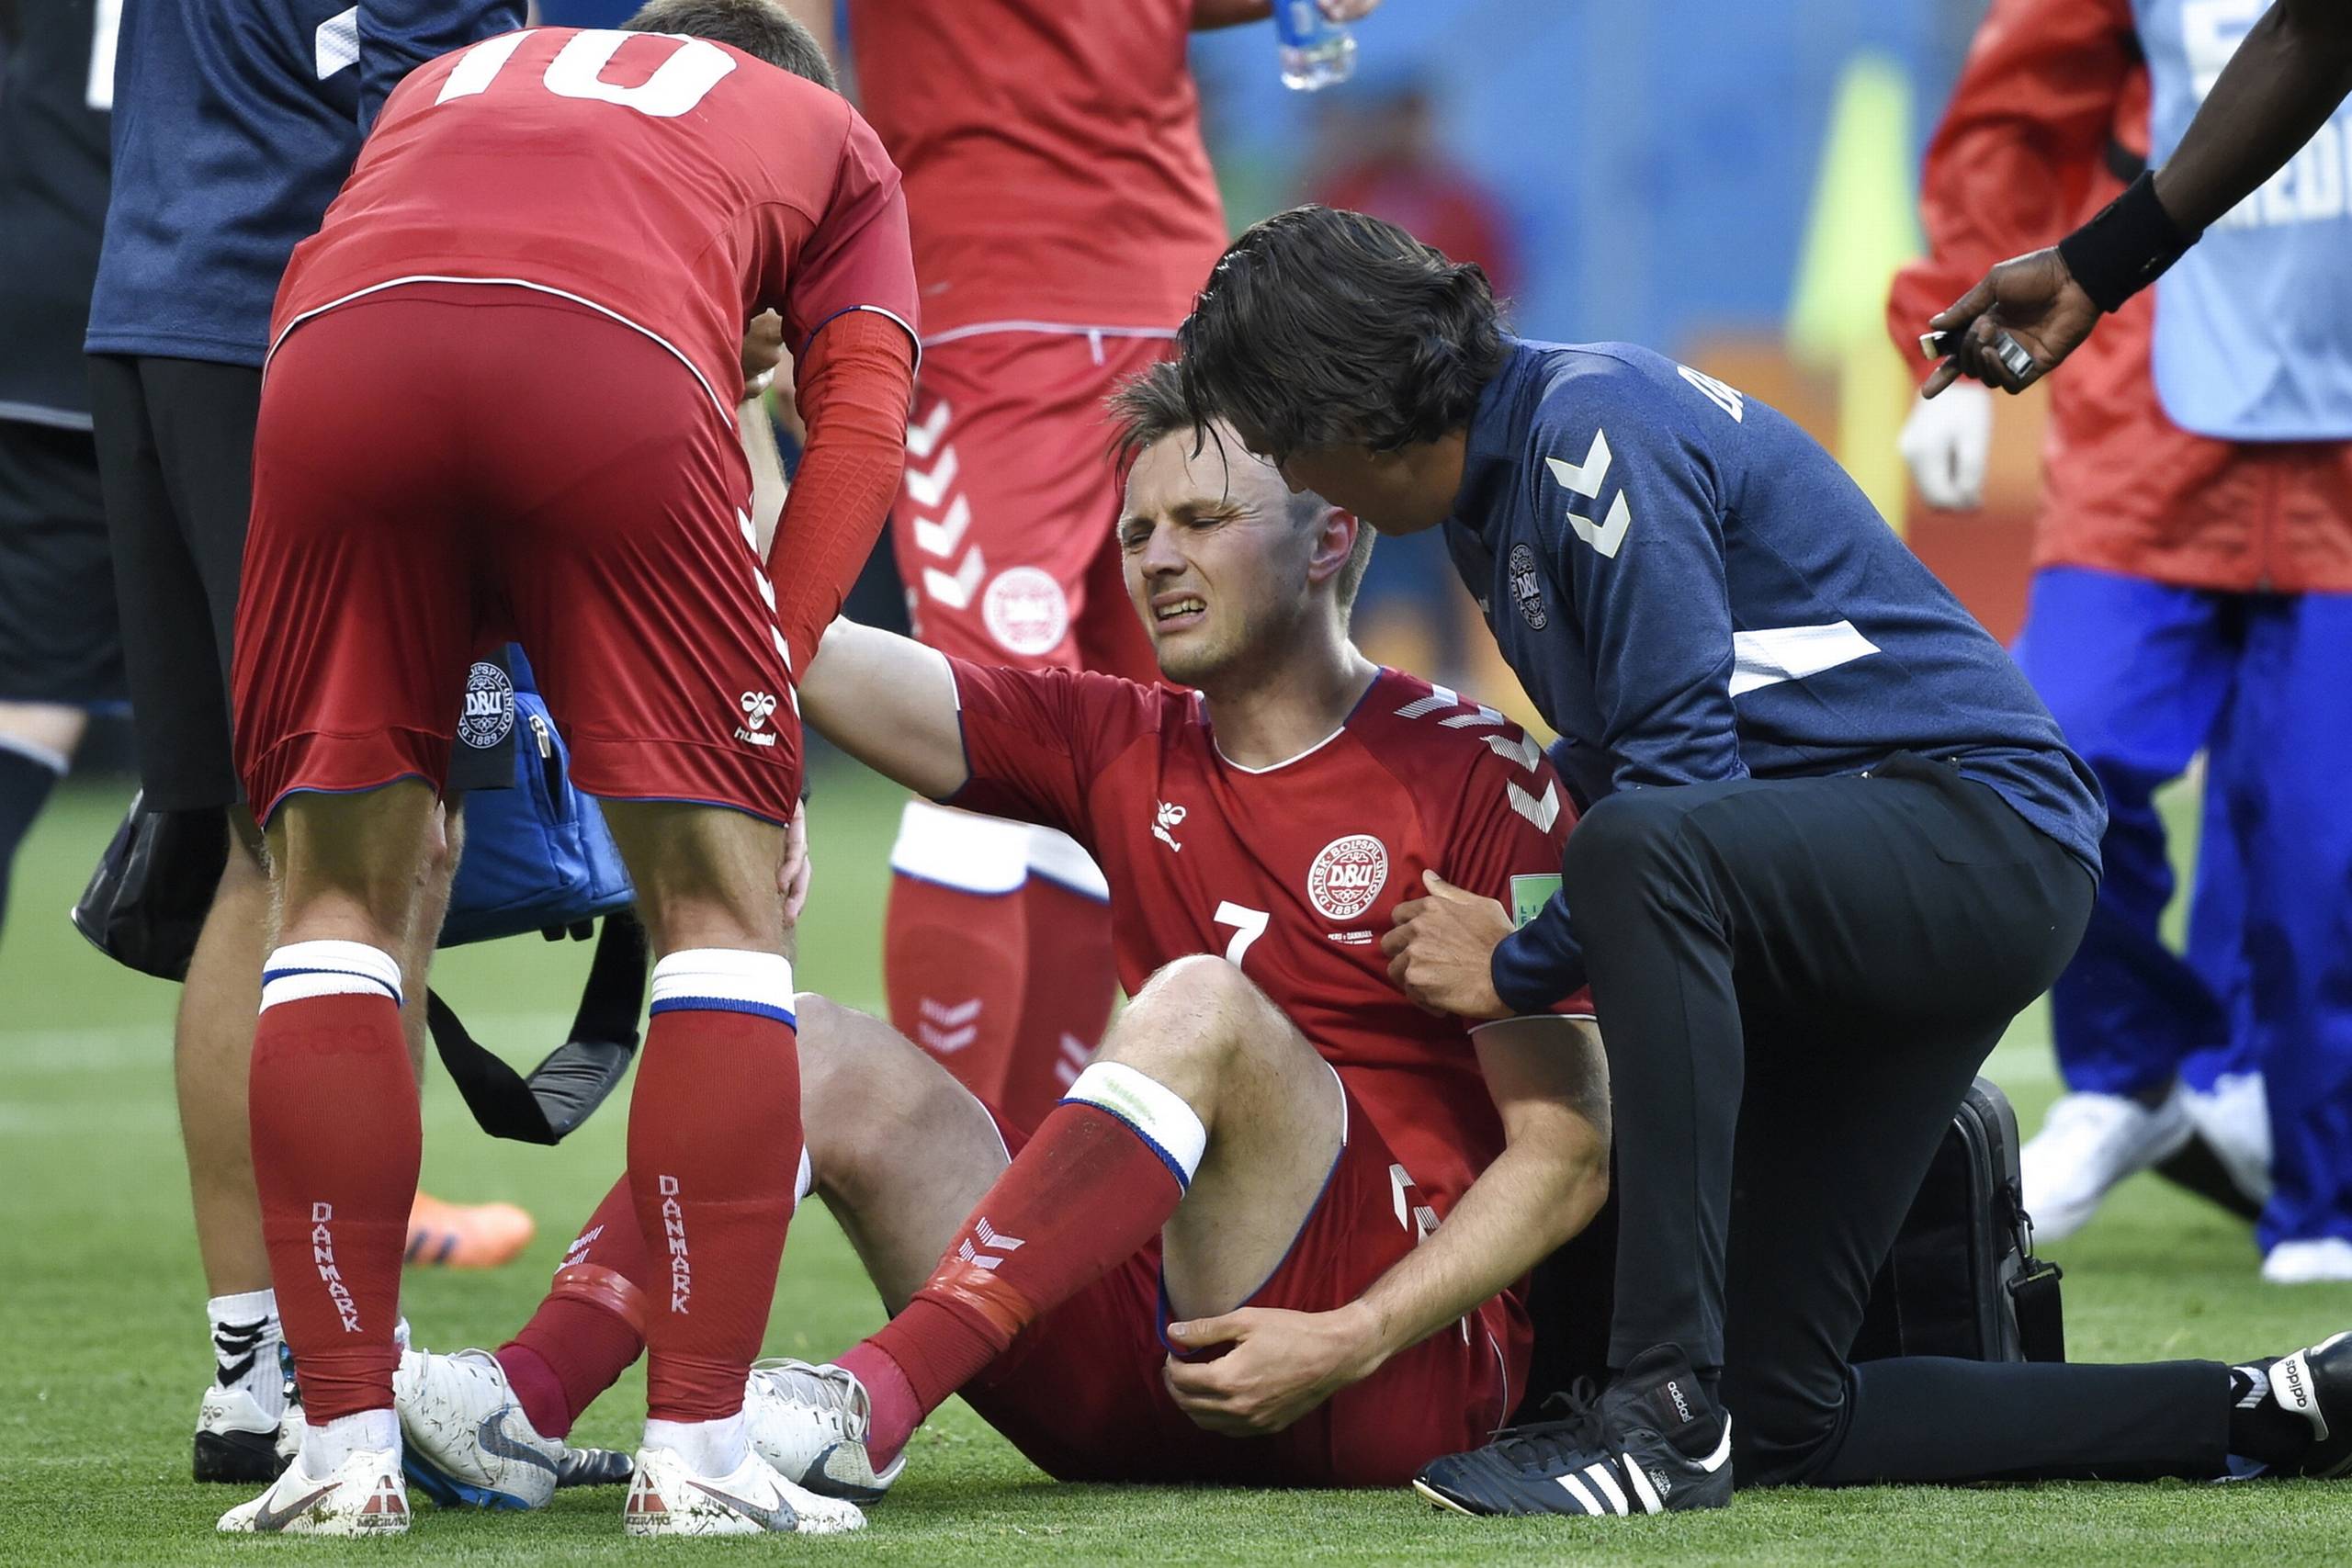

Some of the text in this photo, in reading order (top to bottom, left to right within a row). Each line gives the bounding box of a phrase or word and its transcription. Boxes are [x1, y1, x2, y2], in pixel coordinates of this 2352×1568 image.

[434, 28, 737, 118] 10
[465, 691, 503, 716] DBU
[471, 733, 497, 746] 1889
[1313, 859, 1330, 907] DANSK
[1363, 861, 1385, 904] UNION
[1327, 863, 1374, 888] DBU
[1329, 904, 1360, 915] 1889
[1214, 900, 1270, 970] 7
[311, 1201, 364, 1333] DANMARK
[658, 1175, 691, 1314] DANMARK
[1667, 1381, 1694, 1423] adidas
[2285, 1359, 2308, 1408] adidas
